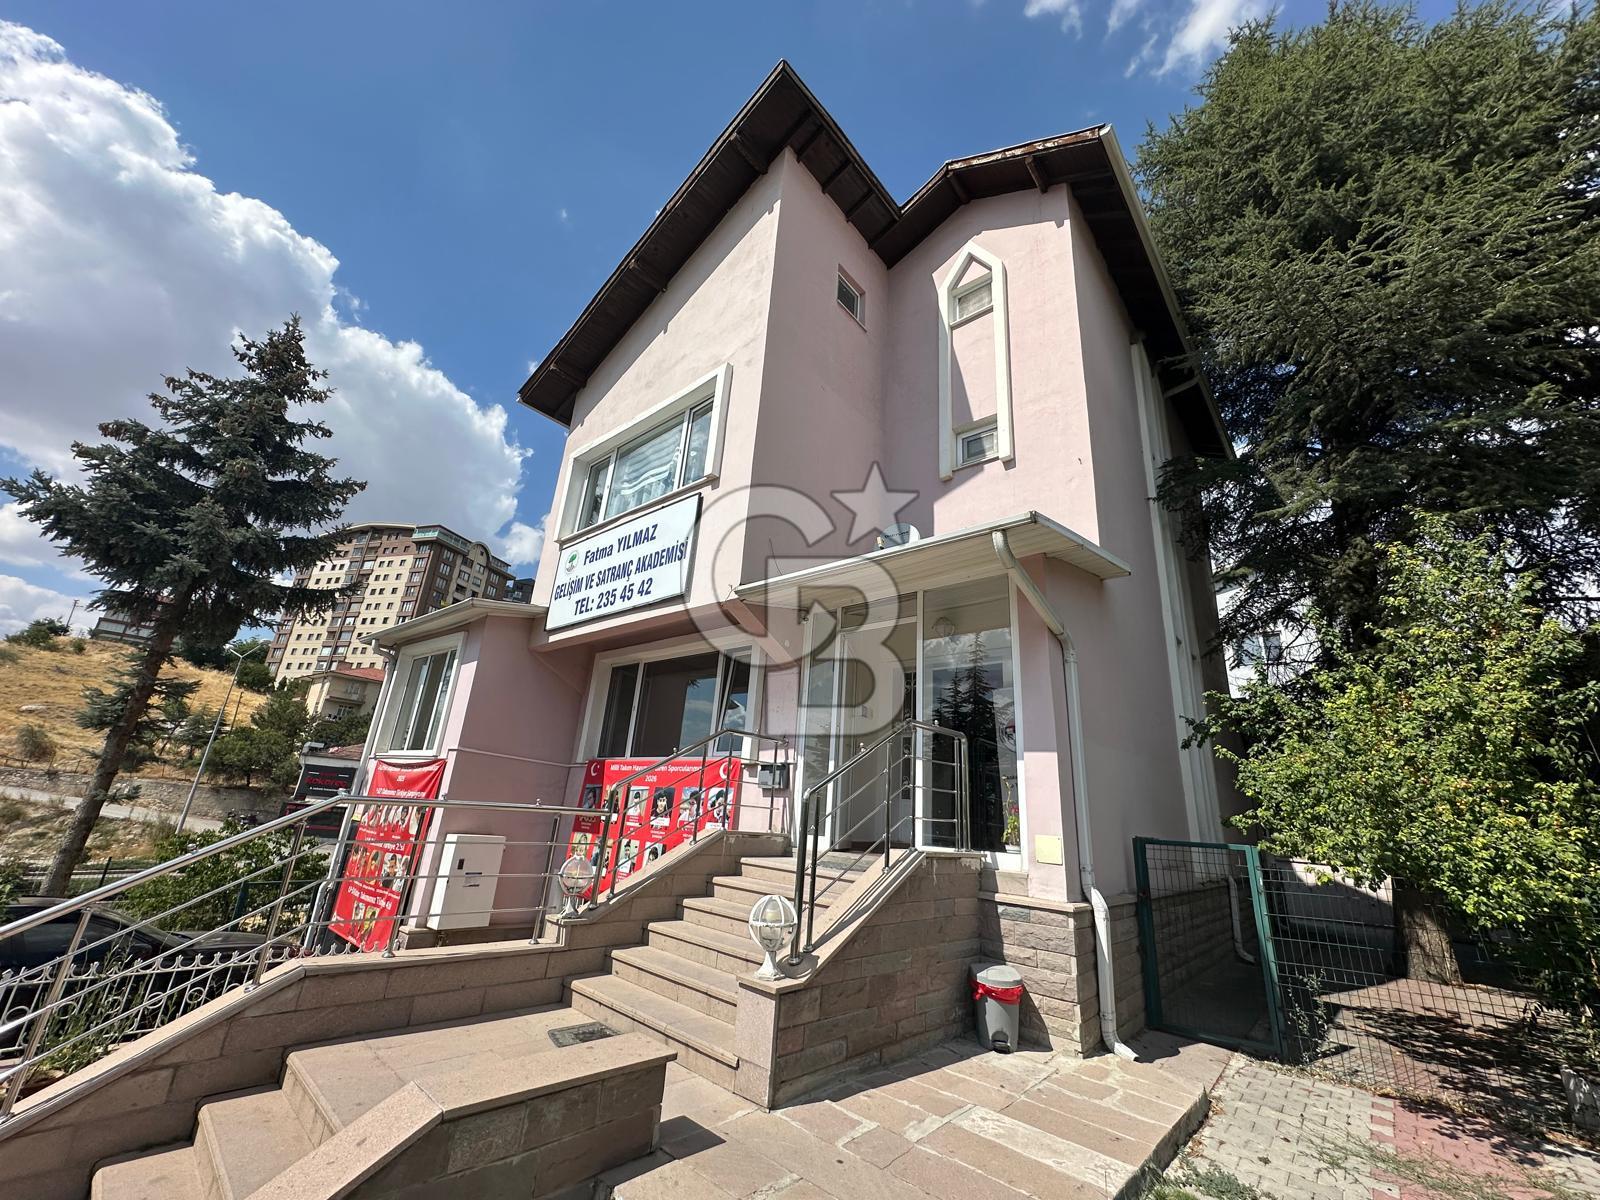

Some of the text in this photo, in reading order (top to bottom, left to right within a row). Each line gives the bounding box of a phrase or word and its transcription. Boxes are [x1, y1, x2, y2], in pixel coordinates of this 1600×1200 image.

[583, 524, 658, 566] Fatma YILMAZ
[554, 536, 689, 601] GELİŞİM VE SATRANÇ AKADEMİSİ
[574, 577, 653, 616] TEL: 235 45 42
